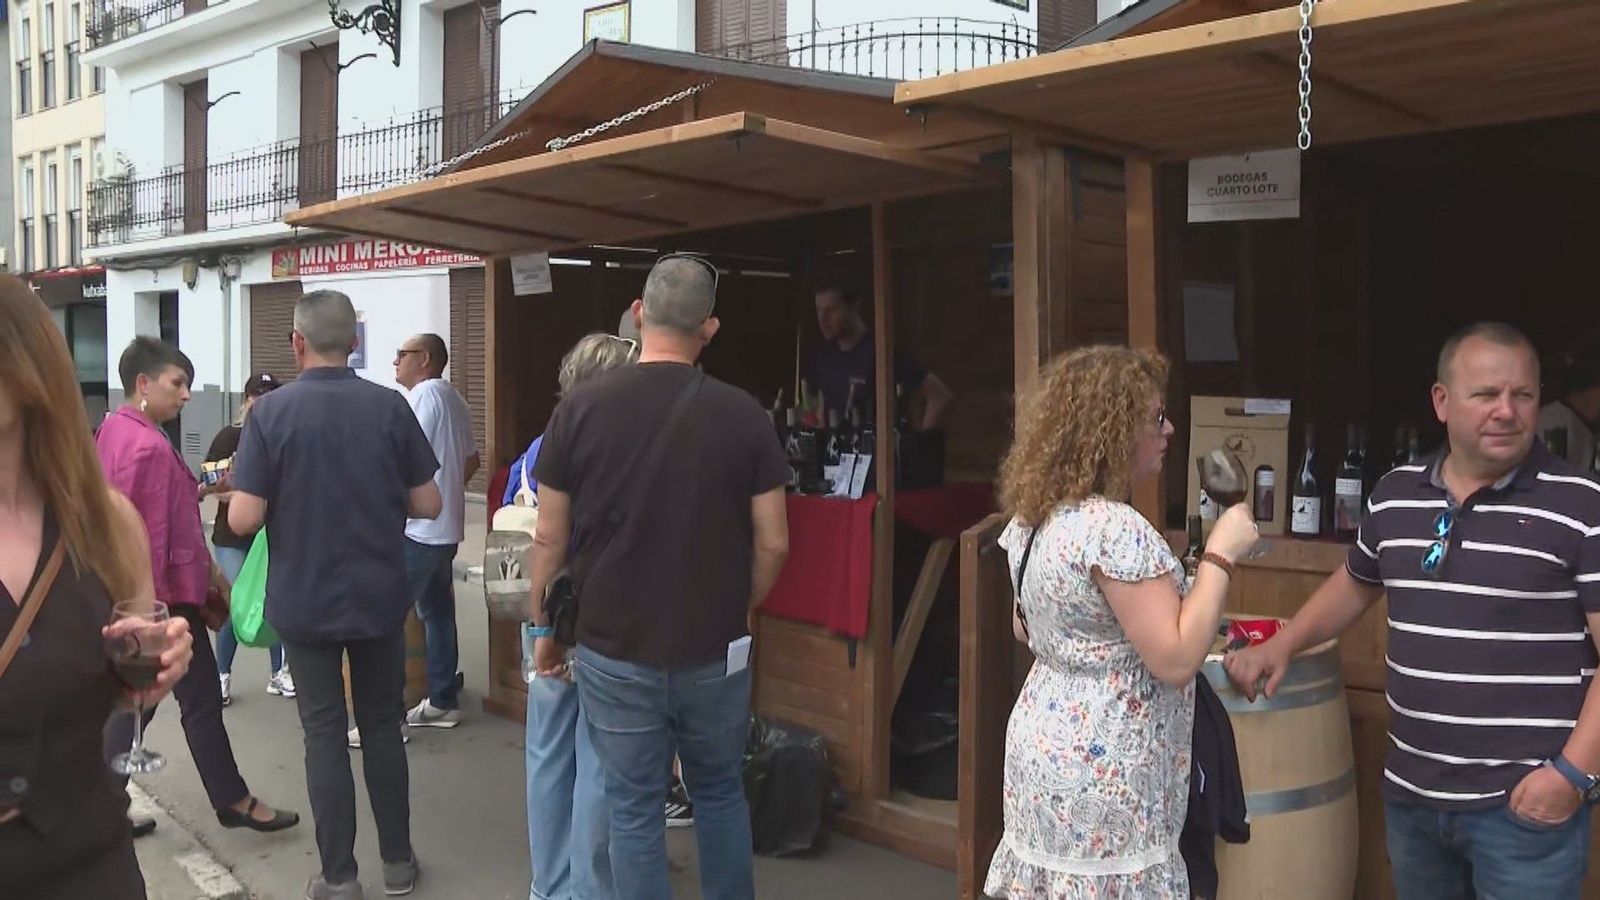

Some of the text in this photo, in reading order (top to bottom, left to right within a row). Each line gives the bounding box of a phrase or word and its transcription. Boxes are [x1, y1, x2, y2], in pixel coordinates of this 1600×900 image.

[1217, 172, 1268, 185] BODEGAS
[1207, 183, 1279, 197] CUARTO LOTE
[300, 244, 347, 265] MINI
[300, 265, 329, 275] BEBIDAS
[335, 261, 368, 272] COCINAS
